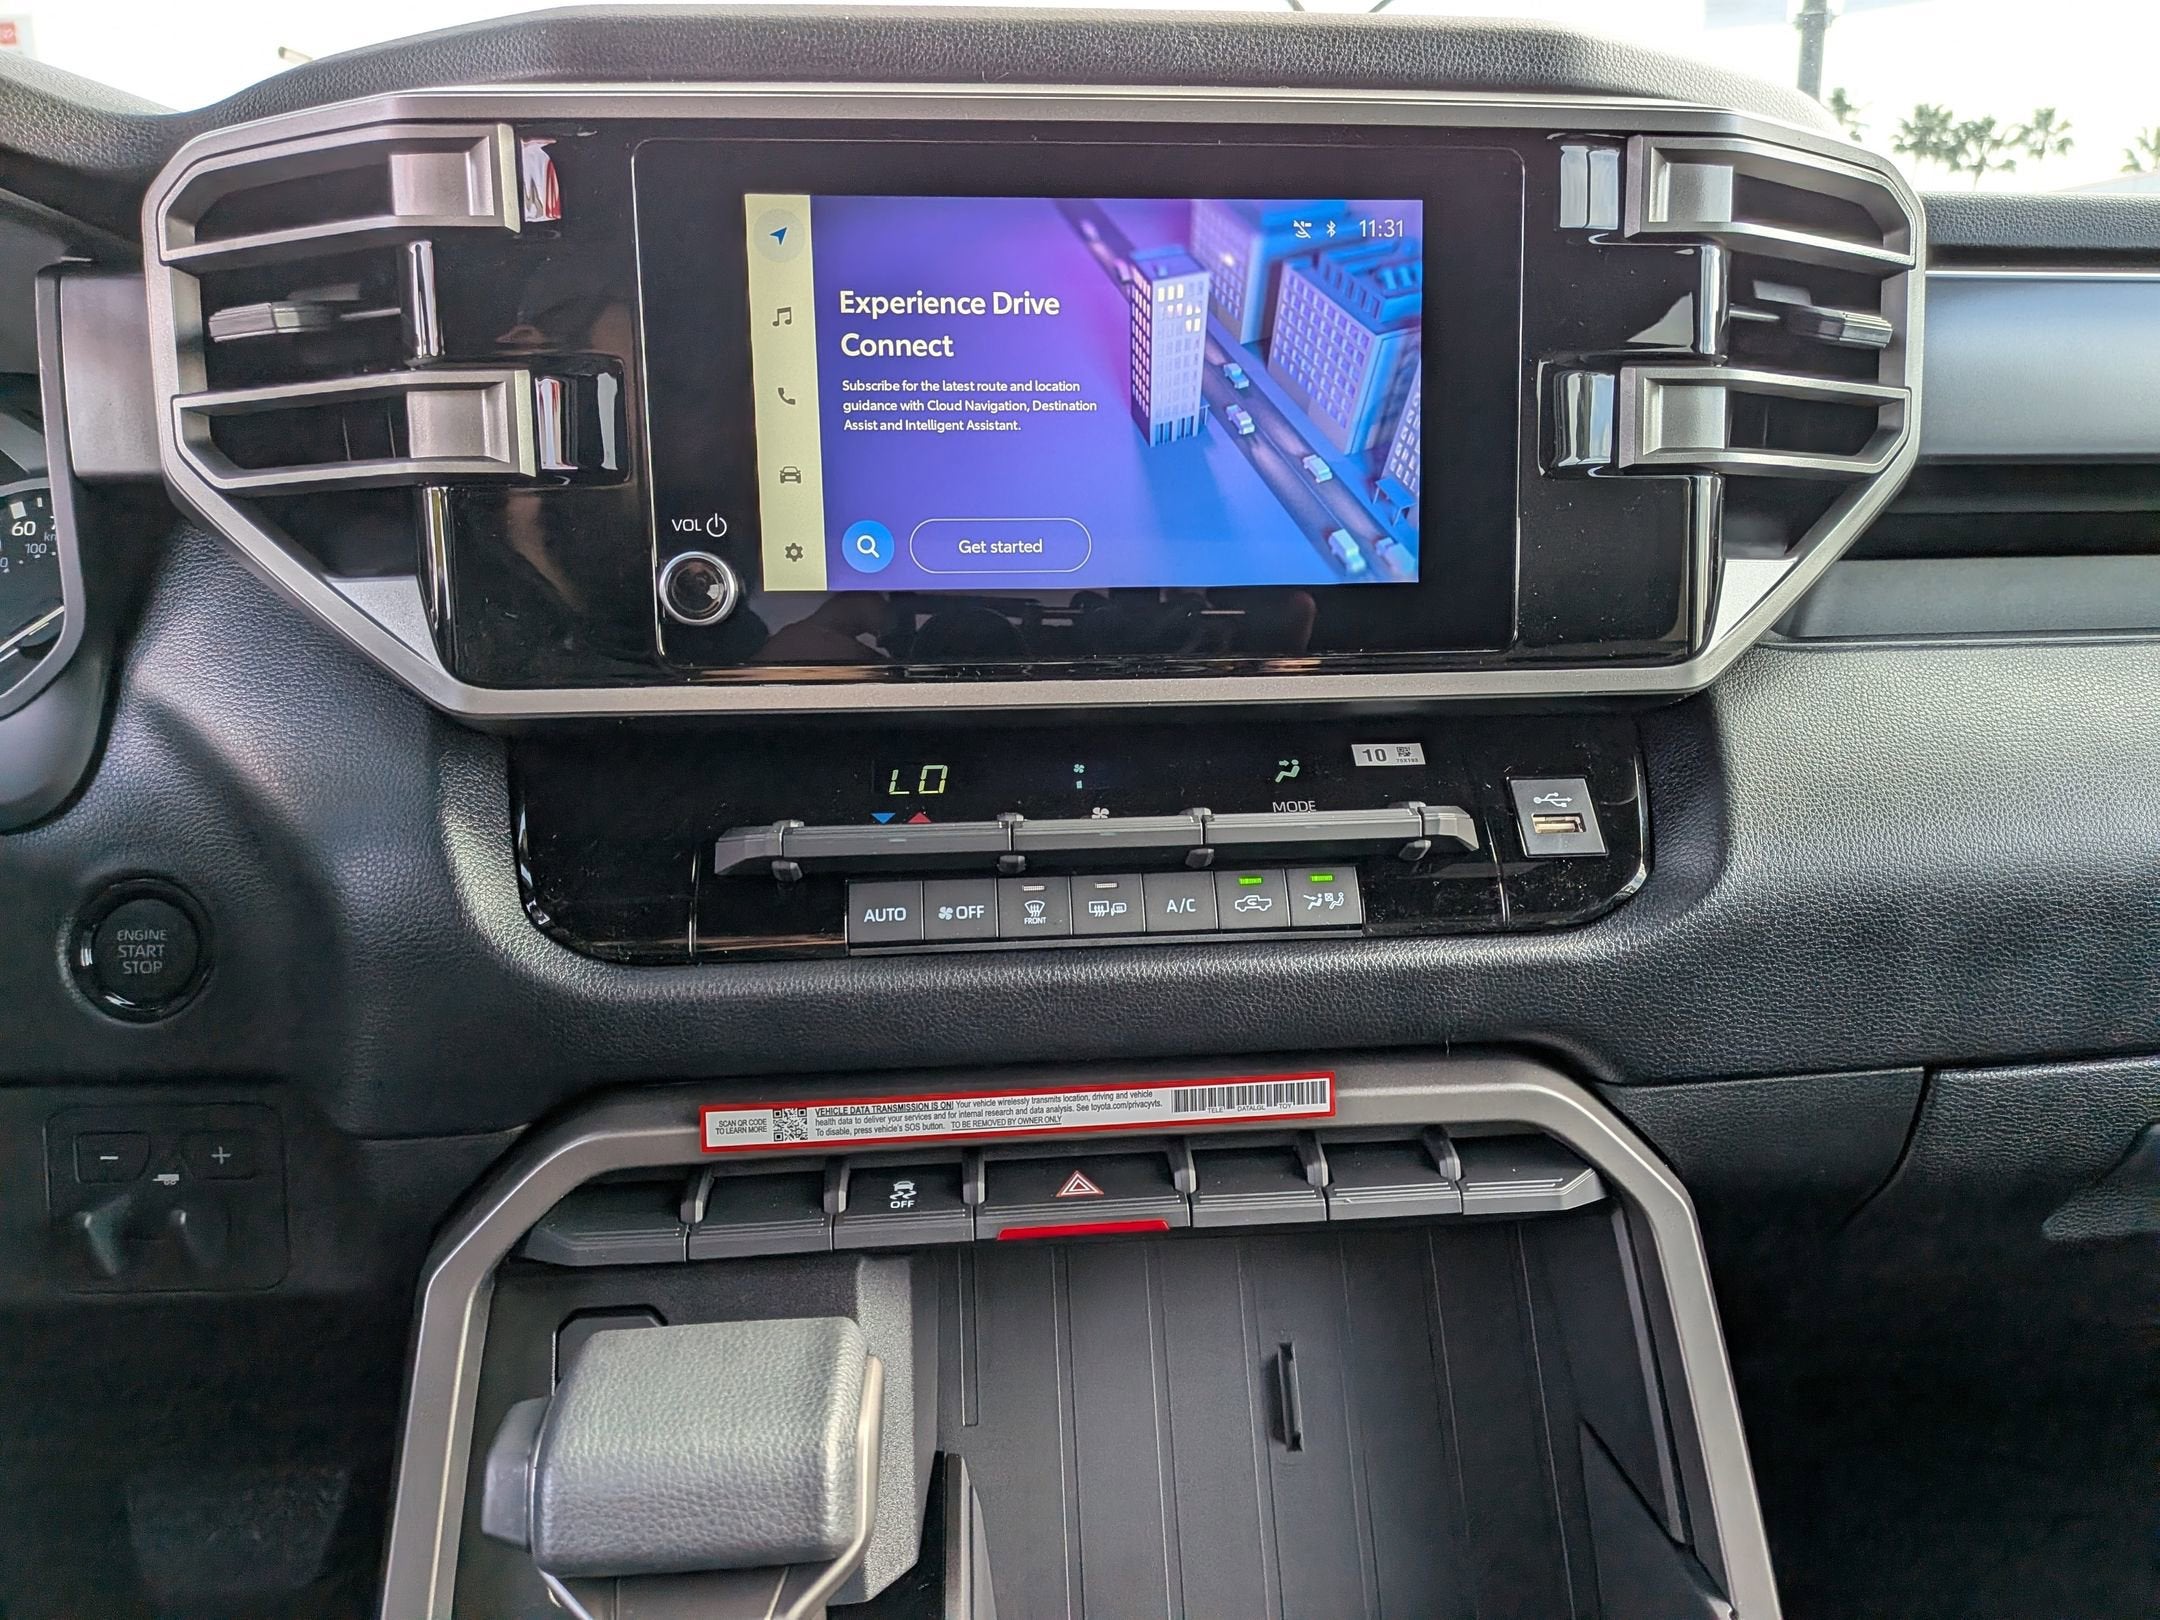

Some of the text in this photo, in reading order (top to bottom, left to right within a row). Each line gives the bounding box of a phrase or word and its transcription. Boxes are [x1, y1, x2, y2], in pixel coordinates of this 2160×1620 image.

[1359, 218, 1404, 238] 11:31
[839, 289, 1060, 320] Experience Drive
[840, 333, 955, 357] Connect
[842, 379, 1081, 392] Subscribe for the latest route and location
[843, 399, 1097, 413] guidance with Cloud Navigation, Destination
[844, 419, 1021, 433] Assist and Intelligent Assistant.
[11, 521, 36, 536] 60
[671, 518, 702, 531] VOL
[25, 543, 47, 554] 100
[958, 538, 1043, 554] Get started
[1362, 748, 1387, 762] 10
[888, 764, 949, 795] LO
[1272, 800, 1317, 813] MODE
[955, 905, 985, 920] OFF
[1166, 898, 1196, 913] A/C
[863, 907, 907, 922] AUTO
[1024, 916, 1047, 925] FRONT
[117, 929, 167, 941] ENGINE
[118, 944, 165, 958] START
[123, 961, 163, 974] STOP
[815, 1106, 849, 1117] VEHICLE
[850, 1105, 870, 1115] DATA
[872, 1102, 930, 1114] TRANSMISSION
[931, 1102, 938, 1110] IS
[956, 1100, 973, 1108] Your
[973, 1098, 996, 1107] vehicle
[997, 1097, 1029, 1106] wirelessly
[1031, 1096, 1060, 1104] transmits
[1062, 1094, 1090, 1103] location,
[1092, 1093, 1113, 1101] driving
[1115, 1091, 1128, 1099] and
[1129, 1090, 1153, 1098] vehicle
[815, 1117, 836, 1126] health
[837, 1116, 853, 1125] data
[855, 1116, 862, 1124] to
[863, 1115, 887, 1124] deliver
[888, 1115, 903, 1124] your
[905, 1113, 931, 1121] services
[933, 1111, 946, 1120] and
[948, 1111, 957, 1119] for
[958, 1109, 983, 1118] internal
[984, 1108, 1014, 1117] research
[1015, 1107, 1028, 1115] and
[1029, 1106, 1044, 1114] data
[1045, 1104, 1074, 1114] analysis.
[1076, 1103, 1089, 1112] See
[749, 1118, 767, 1126] CODE
[815, 1128, 825, 1136] To
[825, 1126, 852, 1136] disable,
[854, 1126, 872, 1136] press
[873, 1123, 903, 1133] vehicle's
[904, 1122, 920, 1131] SOS
[922, 1121, 945, 1130] button.
[951, 1121, 961, 1129] TO
[962, 1120, 971, 1128] BE
[972, 1118, 1006, 1127] REMOVED
[1007, 1117, 1016, 1125] BY
[1017, 1116, 1043, 1125] OWNER
[715, 1127, 725, 1135] TO
[890, 1200, 915, 1209] OFF
